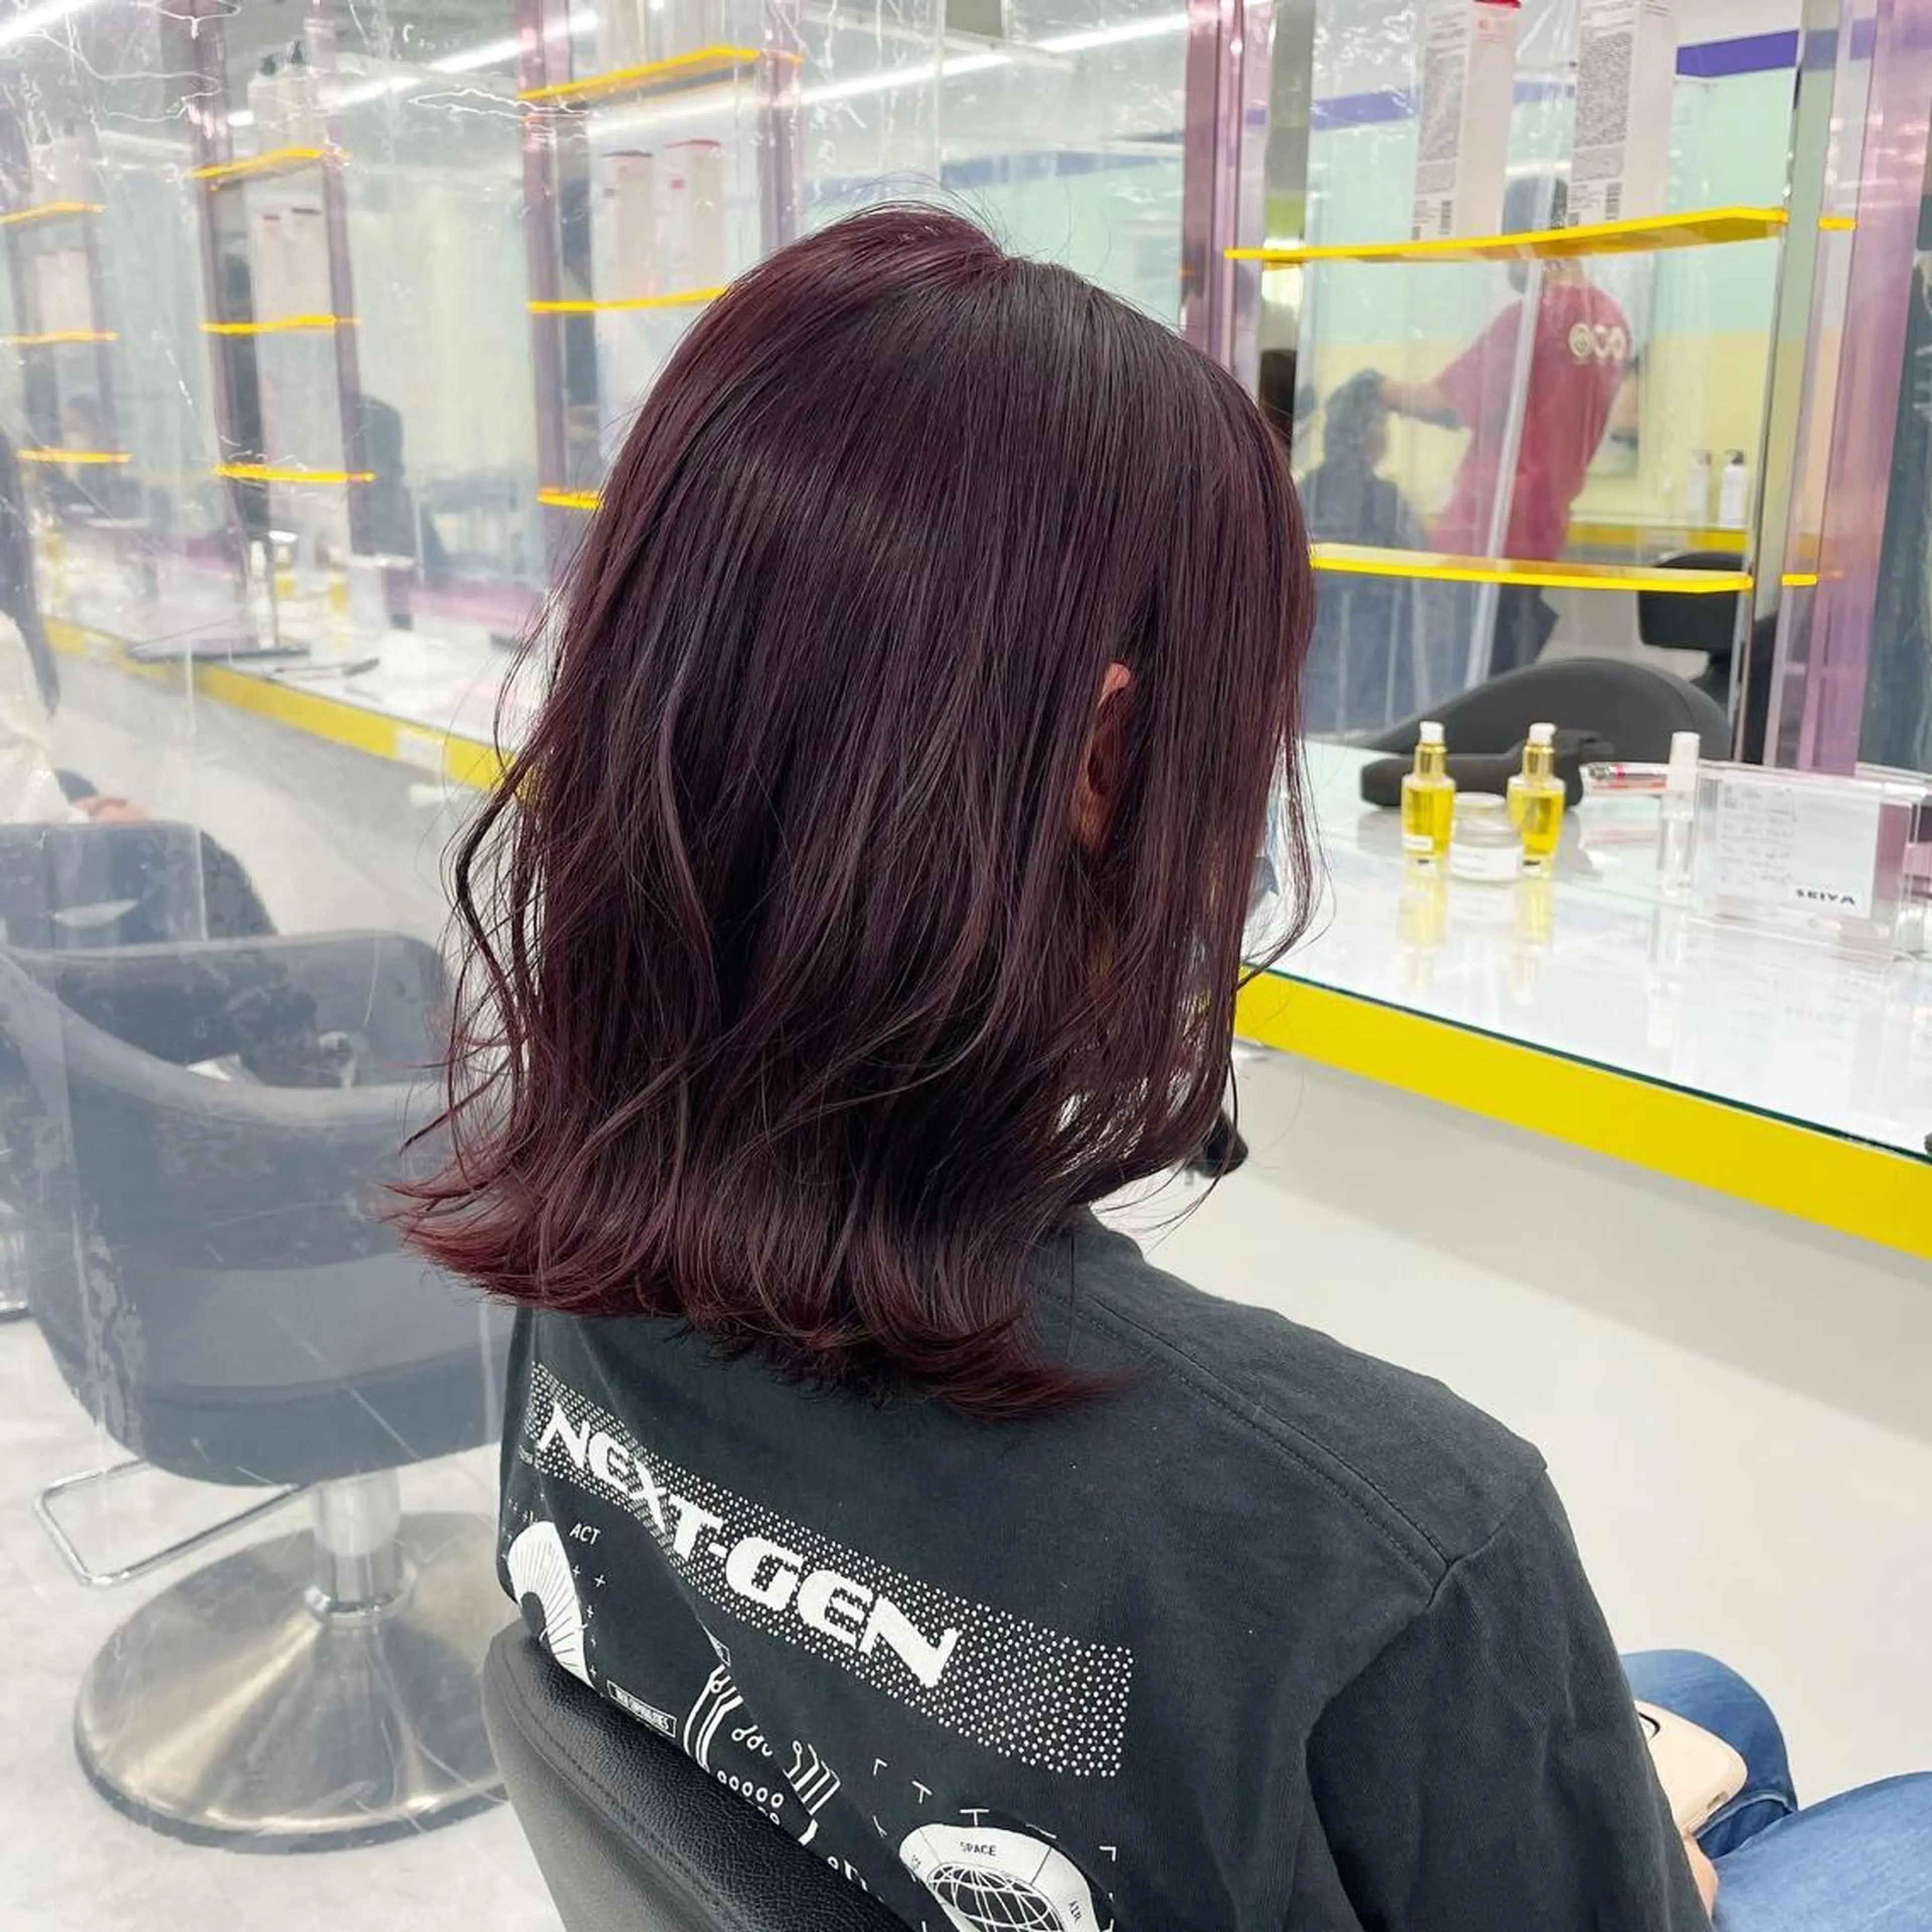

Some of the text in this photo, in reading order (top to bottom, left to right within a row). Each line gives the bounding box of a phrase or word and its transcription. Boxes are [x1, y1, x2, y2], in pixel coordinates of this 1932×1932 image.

[570, 1523, 601, 1545] ACT
[537, 1403, 959, 1688] NEXT-GEN
[960, 1841, 997, 1856] SPACE
